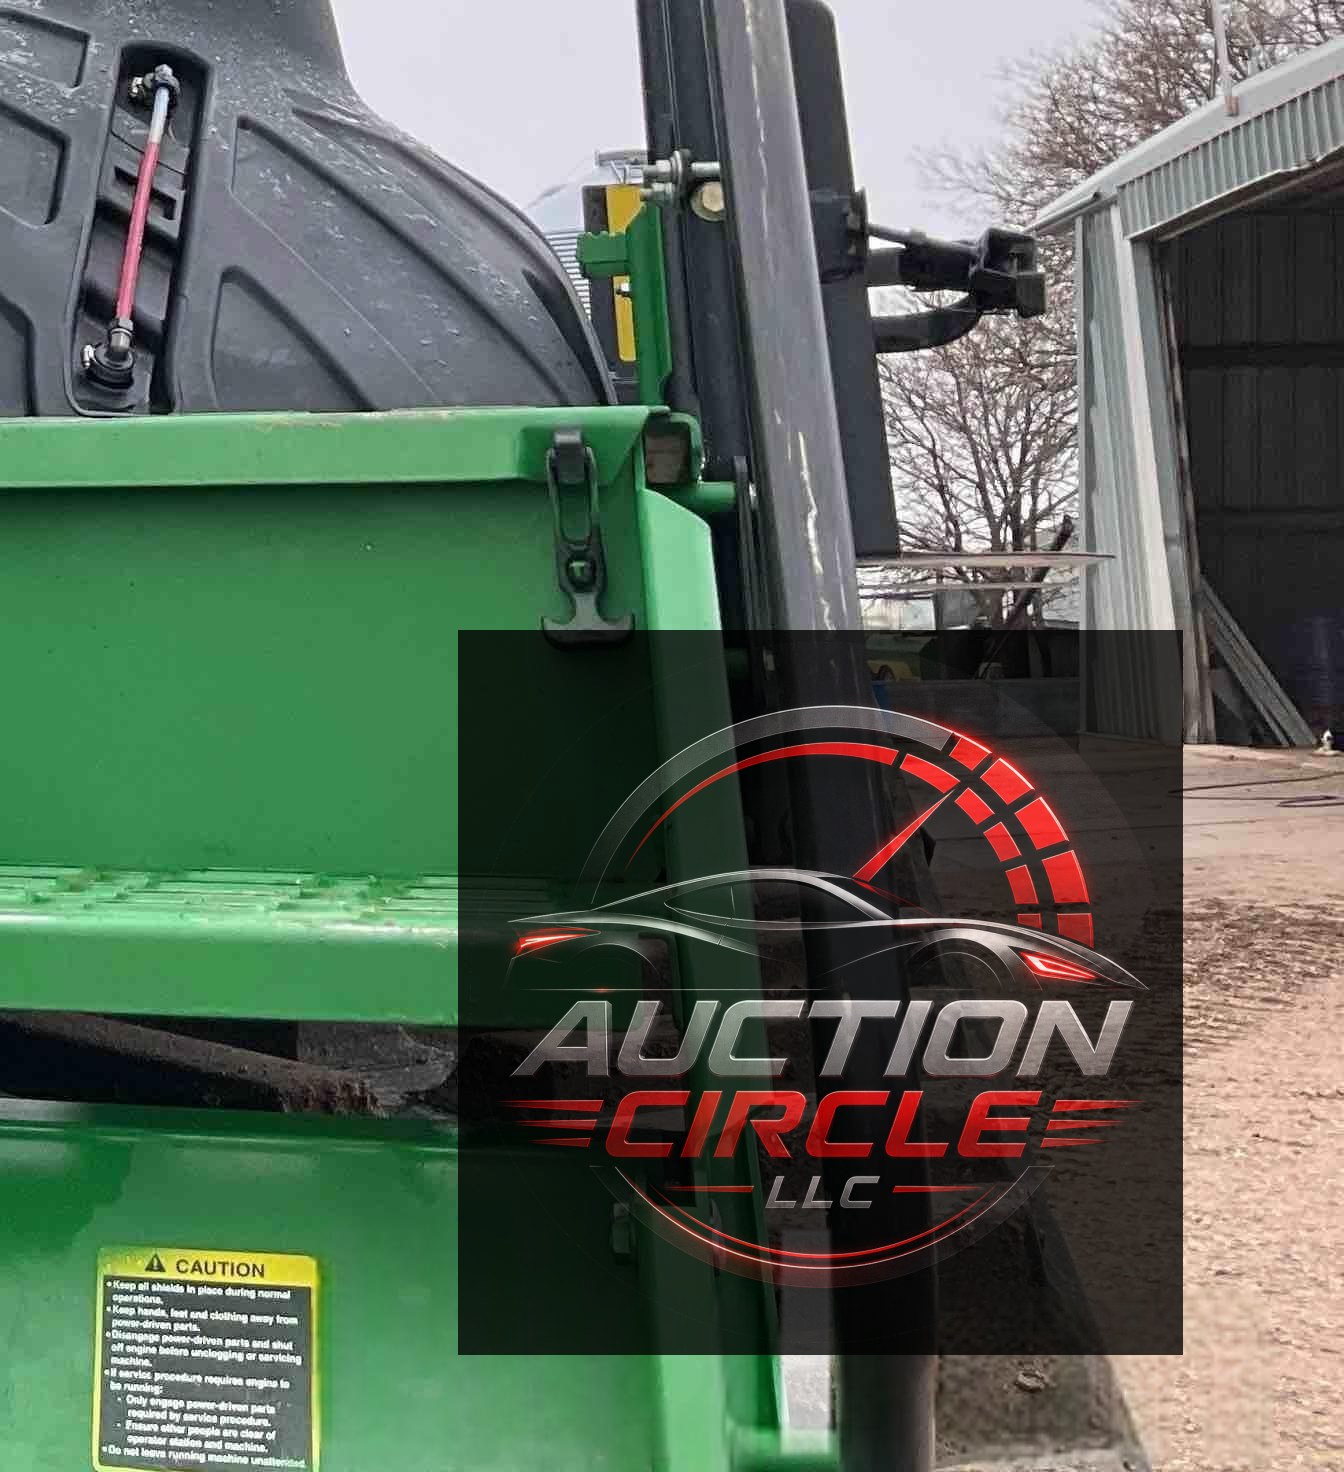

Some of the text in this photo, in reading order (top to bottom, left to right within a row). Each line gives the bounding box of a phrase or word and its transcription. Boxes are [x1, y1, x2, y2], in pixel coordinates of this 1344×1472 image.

[176, 1259, 264, 1278] CAUTION
[112, 1294, 163, 1304] operations.
[113, 1280, 290, 1299] Keep all shields in place during normal
[113, 1305, 298, 1326] Keep hands, feet and clothing away from
[112, 1319, 200, 1332] power-driven parts.
[162, 1335, 223, 1345] power-driven
[225, 1338, 249, 1347] parts
[252, 1339, 270, 1348] and
[272, 1340, 293, 1350] shut
[111, 1343, 123, 1351] off
[125, 1344, 157, 1355] engine
[159, 1345, 189, 1356] before
[191, 1349, 244, 1362] unclogging
[258, 1353, 302, 1365] servicing
[111, 1356, 152, 1366] machine.
[110, 1381, 163, 1395] be running:
[118, 1370, 152, 1379] service
[154, 1372, 202, 1382] procedure
[204, 1375, 243, 1386] requires
[246, 1378, 278, 1389] engine
[280, 1379, 290, 1388] to
[126, 1394, 275, 1414] Only engage power-driven parts
[128, 1409, 167, 1419] required
[169, 1411, 181, 1422] by
[183, 1412, 217, 1423] service
[126, 1420, 276, 1440] Ensure other people are clear of
[127, 1435, 167, 1444] operator
[204, 1440, 222, 1449] and
[224, 1442, 268, 1452] machine.
[108, 1445, 121, 1454] Do
[123, 1447, 139, 1456] not
[141, 1447, 166, 1457] leave
[168, 1450, 206, 1463] running
[208, 1454, 249, 1464] machine
